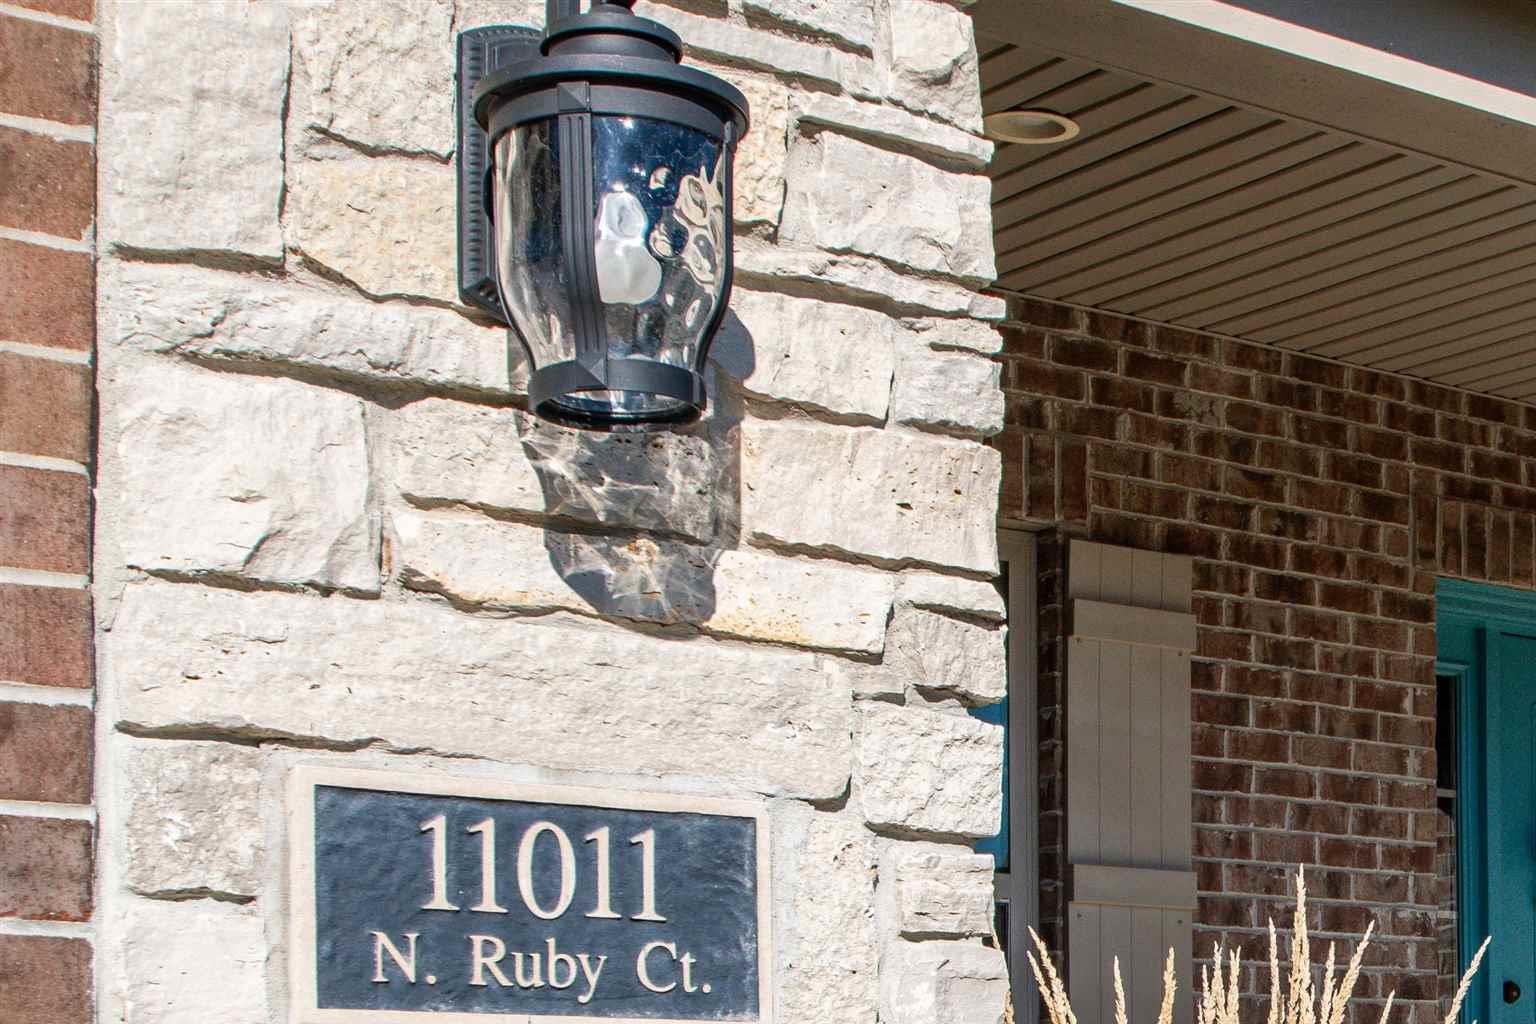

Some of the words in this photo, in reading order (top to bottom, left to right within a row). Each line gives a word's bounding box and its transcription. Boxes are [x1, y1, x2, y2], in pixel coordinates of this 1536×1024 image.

[420, 814, 667, 921] 11011
[370, 930, 437, 985] N.
[468, 934, 608, 1004] Ruby
[636, 940, 712, 994] Ct.
